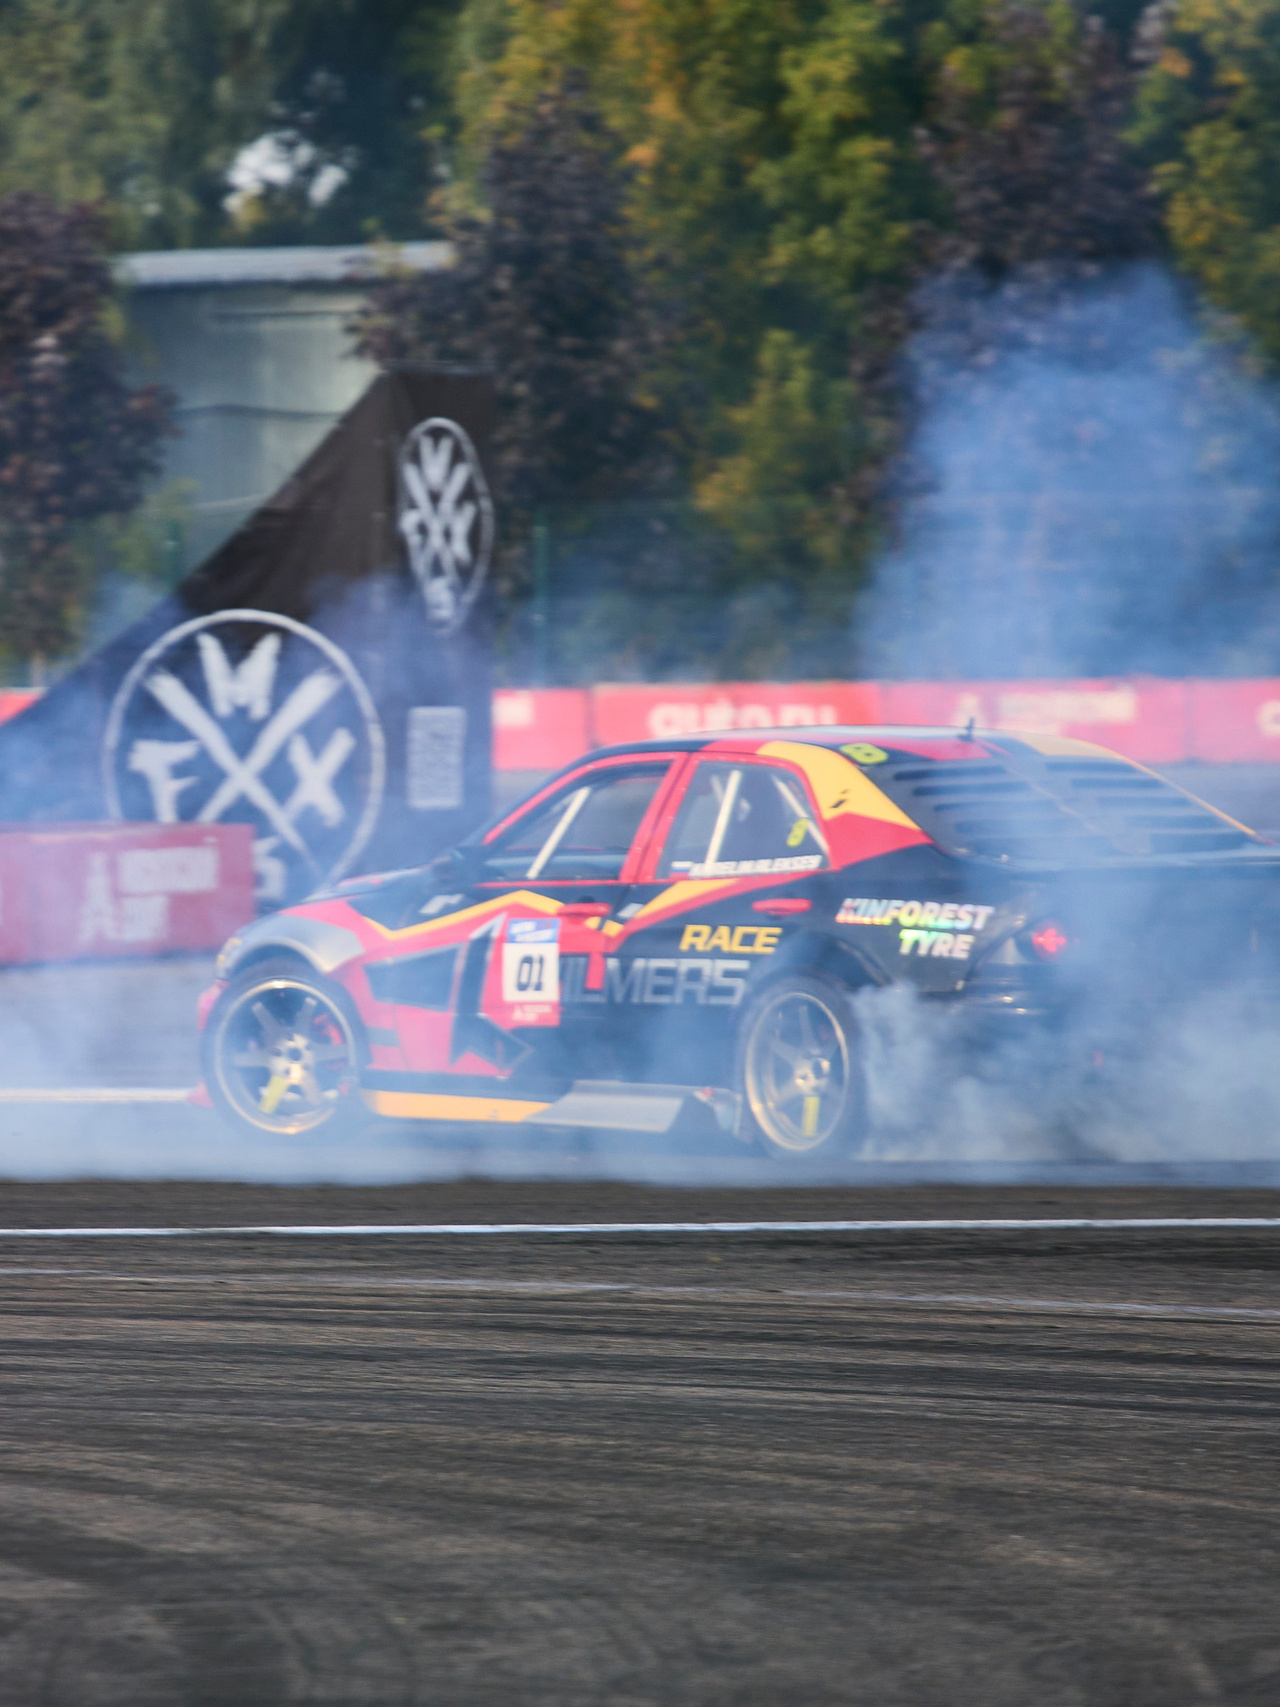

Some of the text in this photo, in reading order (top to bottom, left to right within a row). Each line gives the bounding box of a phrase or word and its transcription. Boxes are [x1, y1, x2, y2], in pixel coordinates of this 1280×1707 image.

[835, 897, 996, 931] KINFOREST
[679, 924, 782, 954] RACE
[898, 929, 975, 959] TYRE
[516, 955, 545, 991] 01
